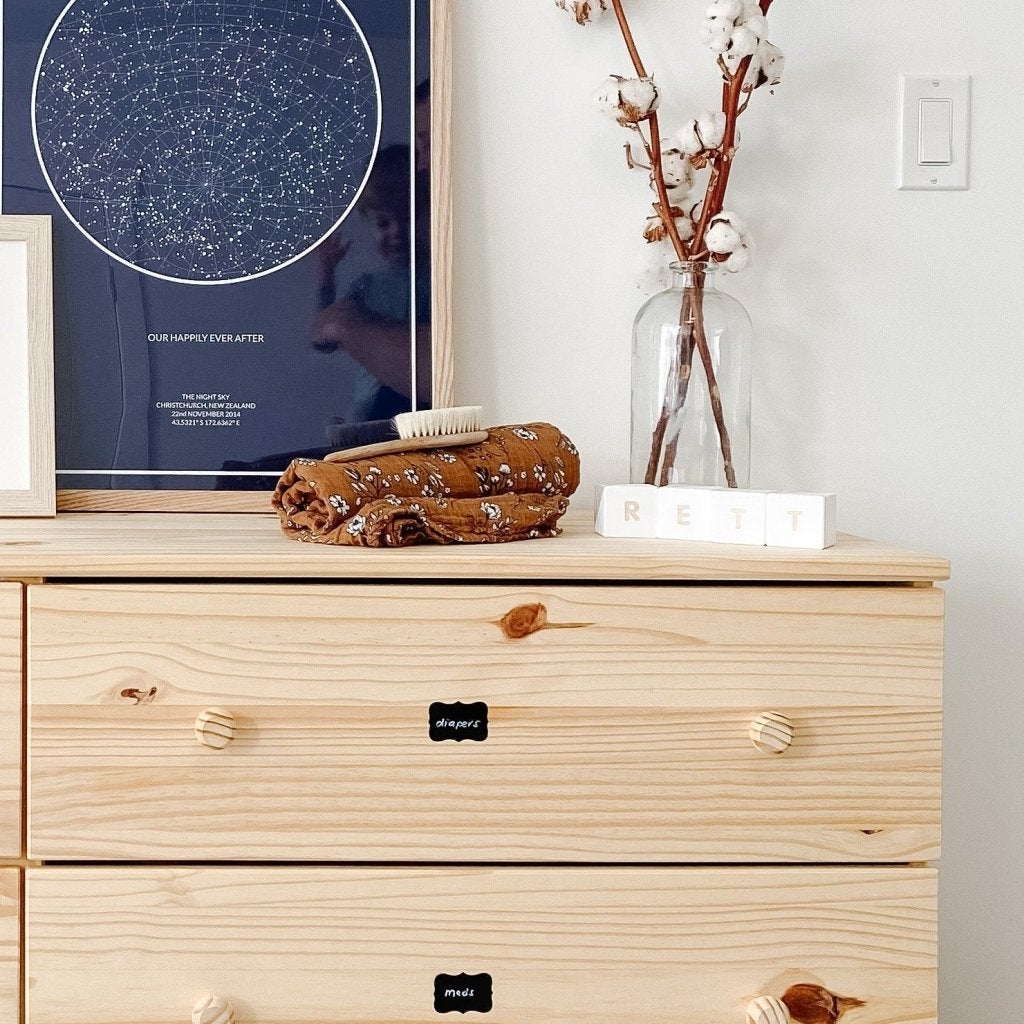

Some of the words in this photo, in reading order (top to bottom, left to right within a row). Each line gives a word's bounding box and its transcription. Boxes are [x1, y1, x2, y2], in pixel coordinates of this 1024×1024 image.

[147, 333, 169, 343] OUR
[170, 333, 209, 343] HAPPILY
[209, 333, 234, 343] EVER
[234, 334, 265, 344] AFTER
[181, 393, 195, 401] THE
[195, 393, 217, 401] NIGHT
[217, 393, 231, 401] SKY
[155, 401, 208, 410] CHRISTCHURCH,
[208, 402, 225, 410] NEW
[225, 402, 257, 410] ZEALAND
[171, 410, 187, 418] 22nd
[435, 718, 482, 730] diapers
[444, 987, 475, 998] meds
